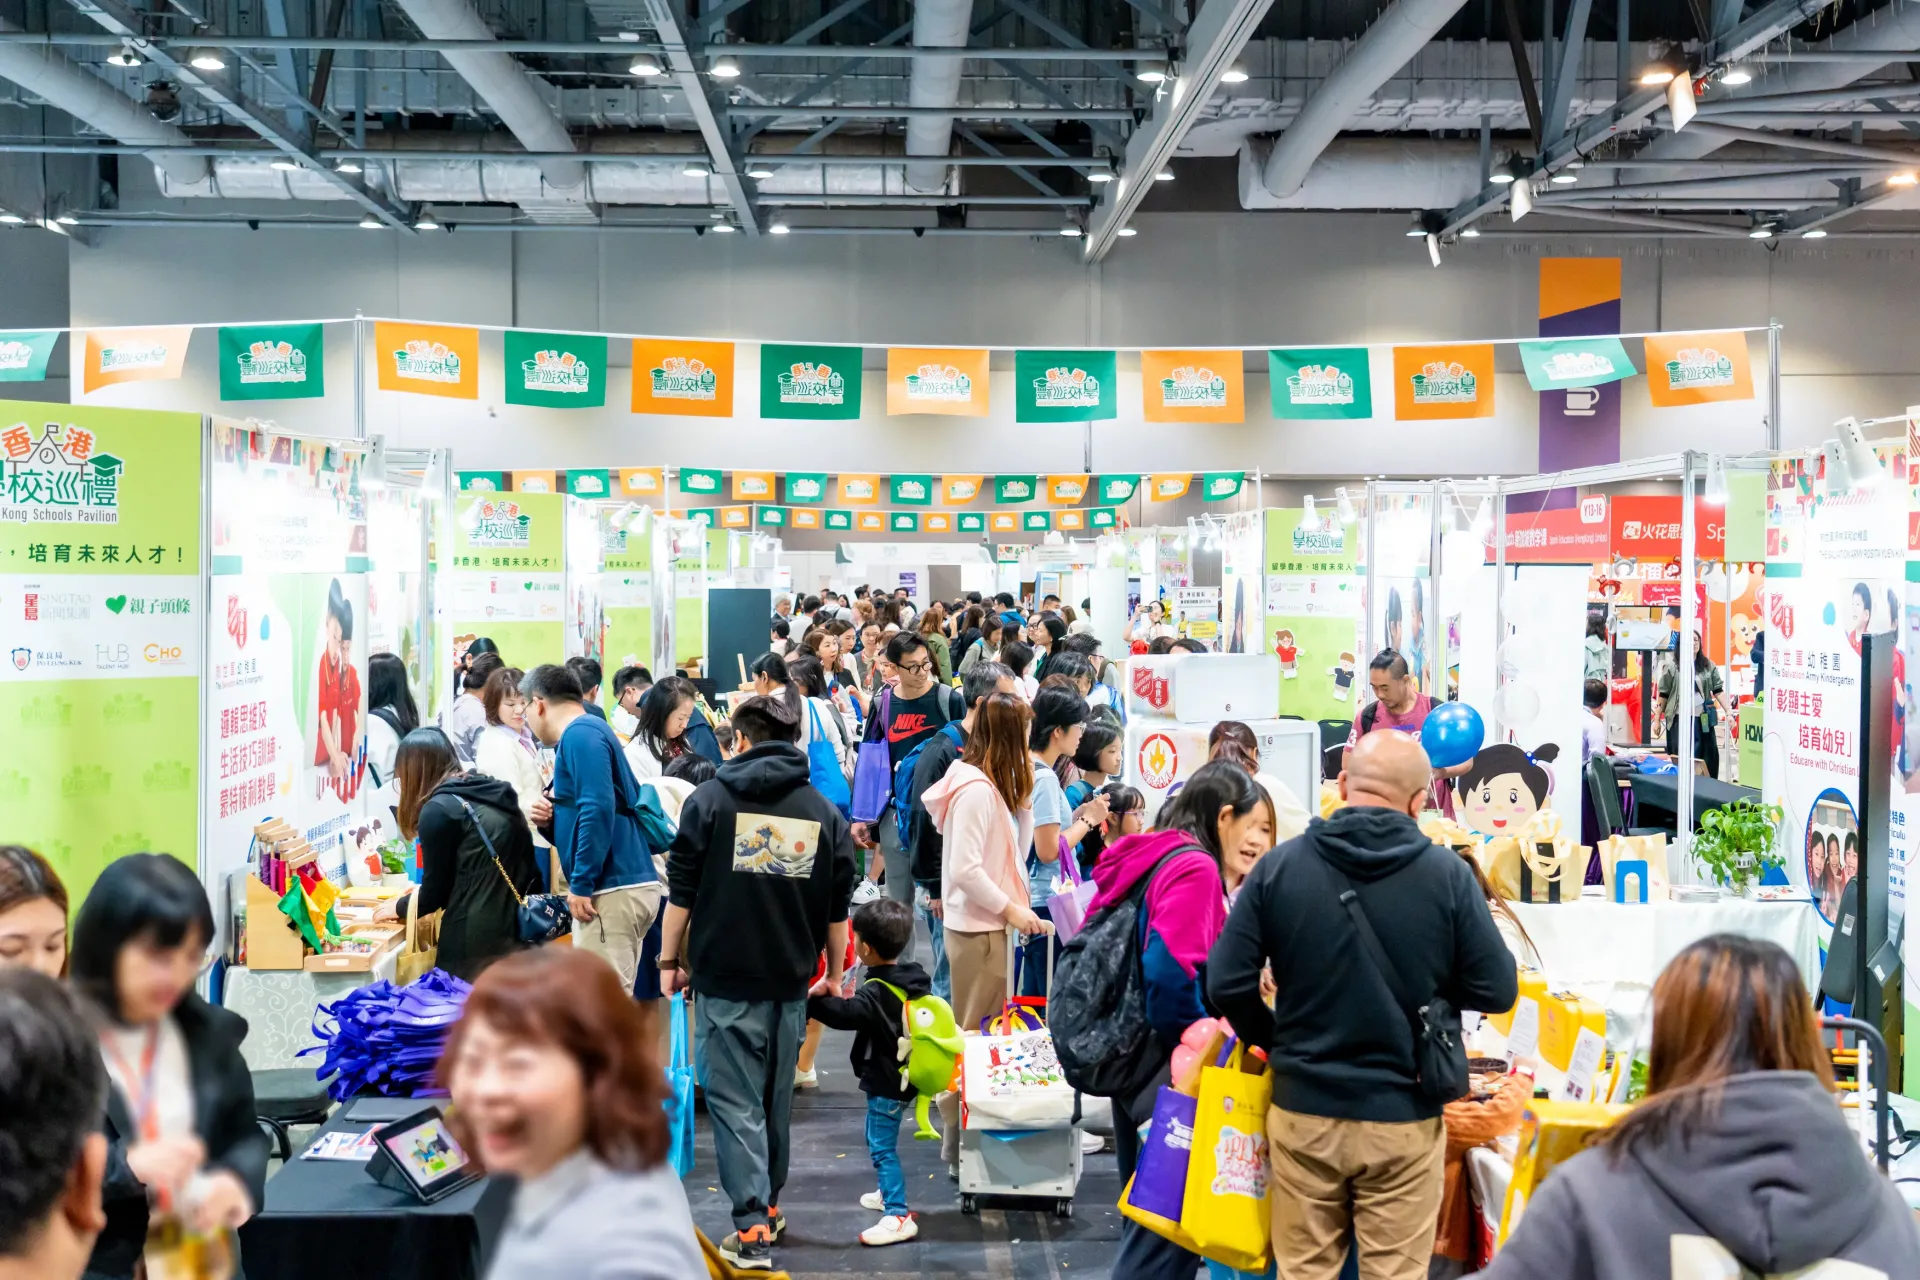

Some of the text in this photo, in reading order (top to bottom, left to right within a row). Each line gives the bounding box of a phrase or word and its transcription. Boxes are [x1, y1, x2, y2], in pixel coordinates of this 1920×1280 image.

[2, 507, 117, 523] Kong Schools Pavilion
[1584, 503, 1603, 517] Y13-16
[1, 543, 182, 564] ，培育未來人才！
[130, 598, 190, 615] 親子頭條
[220, 700, 267, 740] 邏輯思維及
[893, 713, 927, 730] NIKE
[1798, 723, 1852, 758] 培育幼兒」
[220, 735, 276, 780] 生活技巧訓練
[1790, 752, 1814, 767] Educare
[1815, 758, 1828, 770] with
[1829, 760, 1856, 777] Christian
[1889, 810, 1905, 826] 特色
